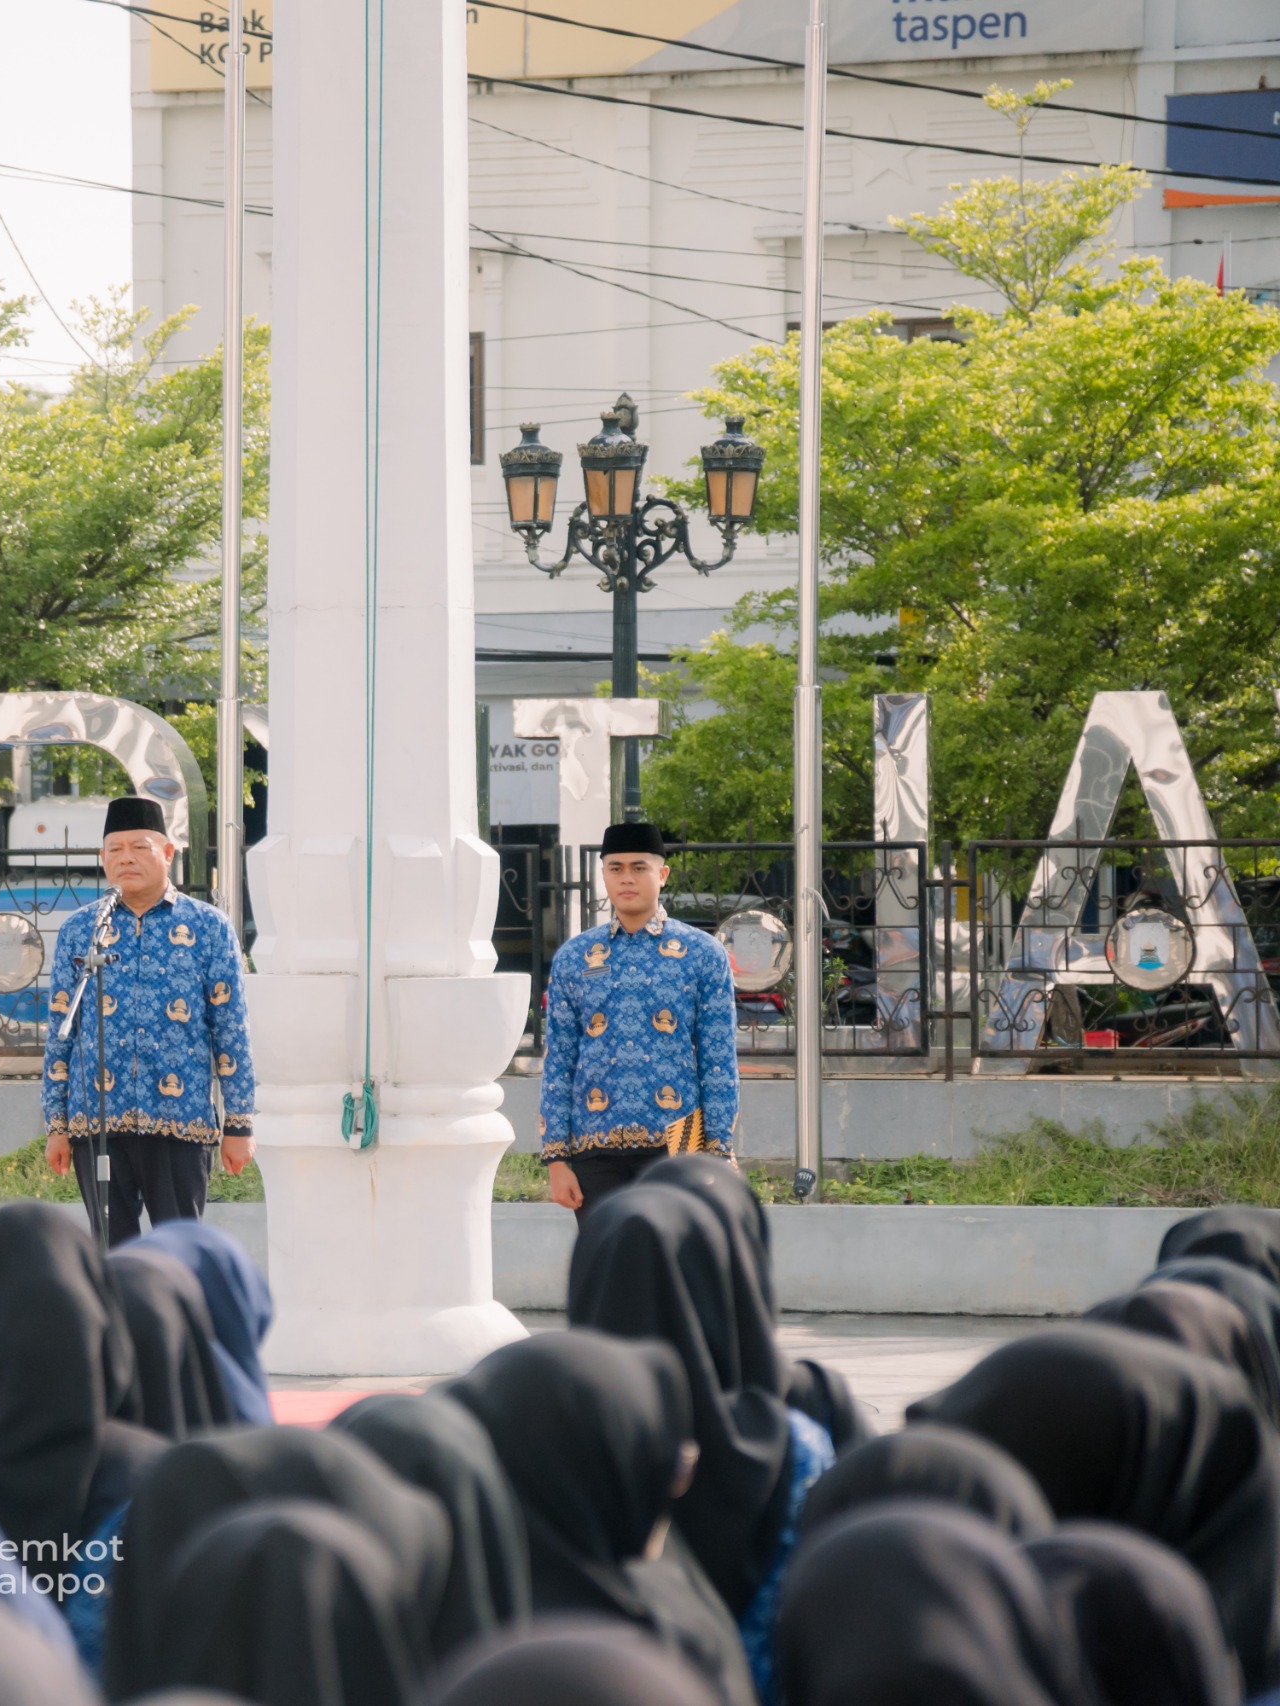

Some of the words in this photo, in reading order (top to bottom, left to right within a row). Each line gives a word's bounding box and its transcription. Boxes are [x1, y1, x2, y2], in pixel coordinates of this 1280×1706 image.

[893, 11, 1027, 50] taspen
[490, 743, 526, 758] YAK
[531, 743, 560, 758] GO
[531, 762, 553, 772] dan
